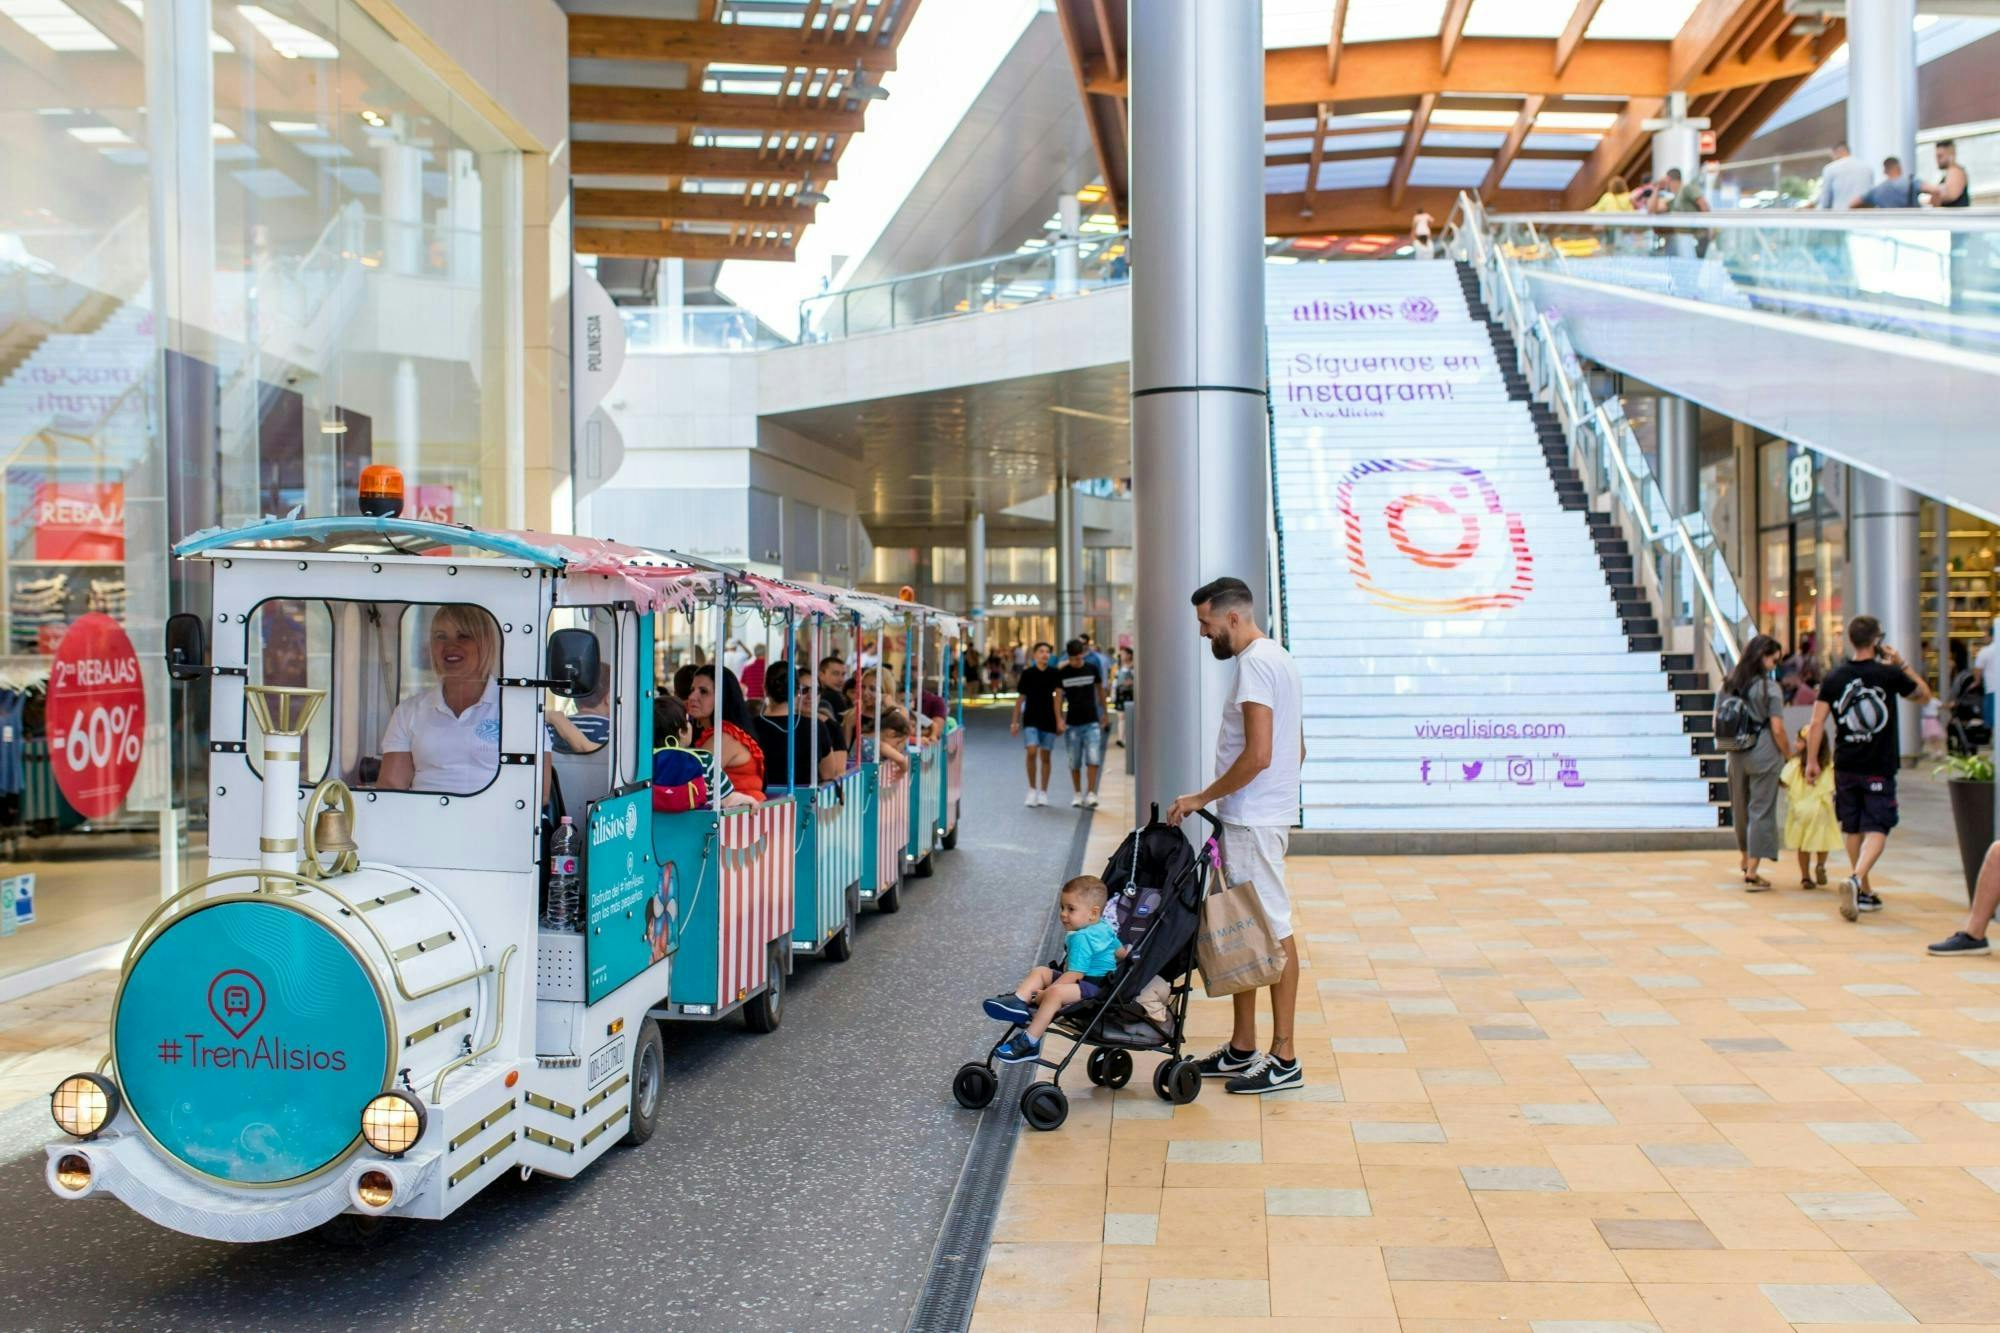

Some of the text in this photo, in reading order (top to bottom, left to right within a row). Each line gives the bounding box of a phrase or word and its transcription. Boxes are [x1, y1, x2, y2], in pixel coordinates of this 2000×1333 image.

[586, 315, 602, 371] POLINESIA
[992, 593, 1040, 606] ZARA
[77, 657, 136, 686] REBAJAS
[1415, 718, 1565, 738] vivealisios.com
[593, 813, 625, 846] alisios
[157, 1035, 347, 1071] #TrenAlisios
